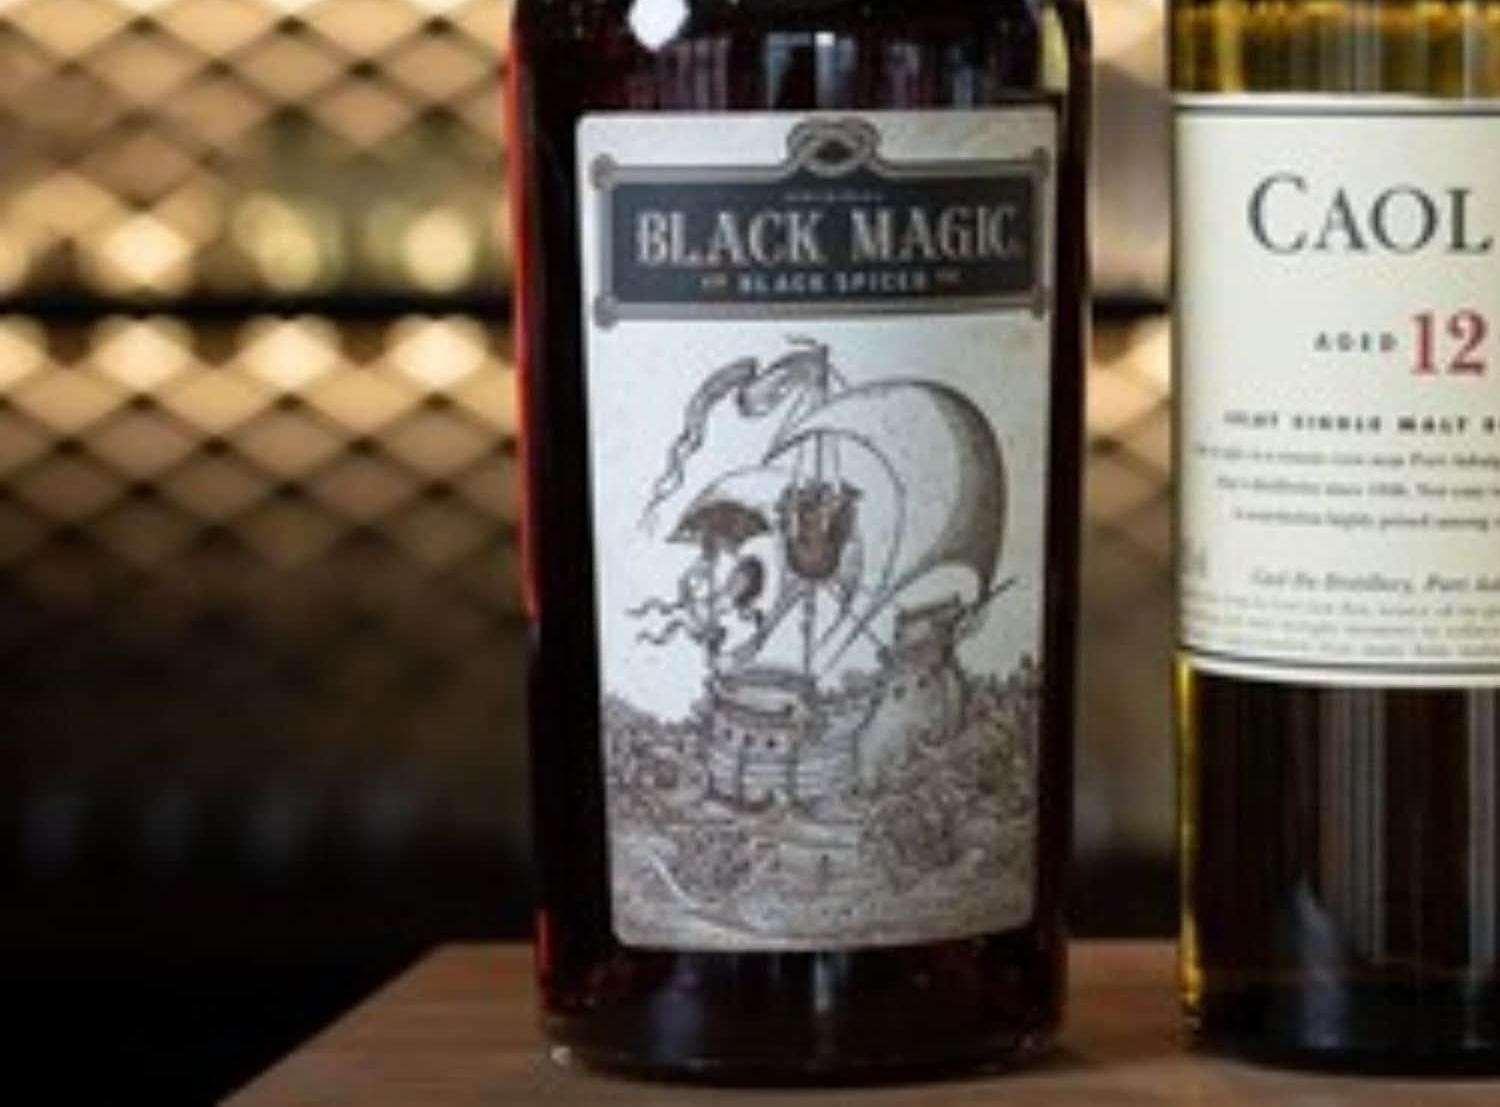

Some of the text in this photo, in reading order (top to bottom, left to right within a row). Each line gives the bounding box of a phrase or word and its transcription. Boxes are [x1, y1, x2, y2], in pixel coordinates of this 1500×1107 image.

[636, 204, 1020, 266] BLACK MAGIC
[1247, 172, 1494, 255] CAOL
[1313, 331, 1398, 352] AGED
[1411, 308, 1489, 377] 12
[1396, 415, 1468, 435] MALT
